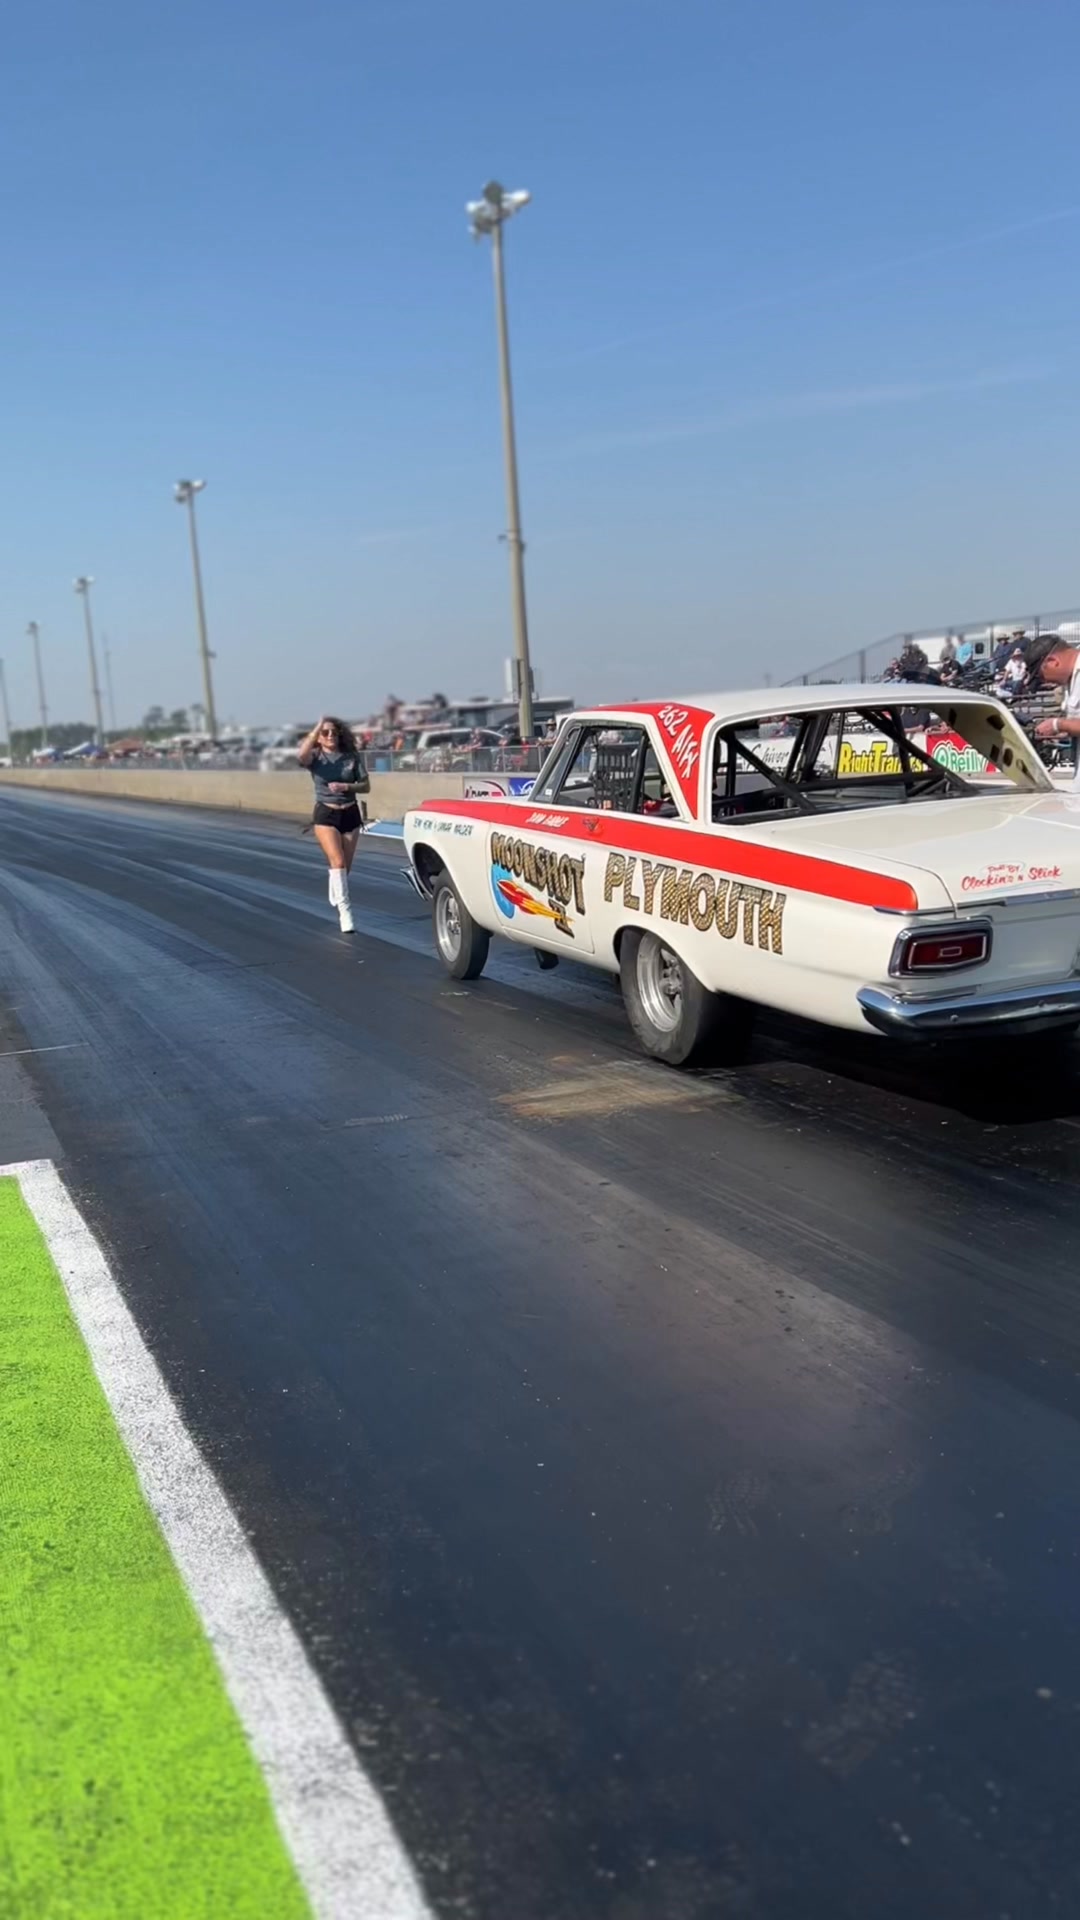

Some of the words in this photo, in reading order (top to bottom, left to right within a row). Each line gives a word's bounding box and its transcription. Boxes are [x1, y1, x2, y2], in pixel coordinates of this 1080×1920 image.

[658, 705, 689, 736] 262
[490, 831, 586, 916] MOONSHOT
[604, 852, 787, 955] PLYMOUTH
